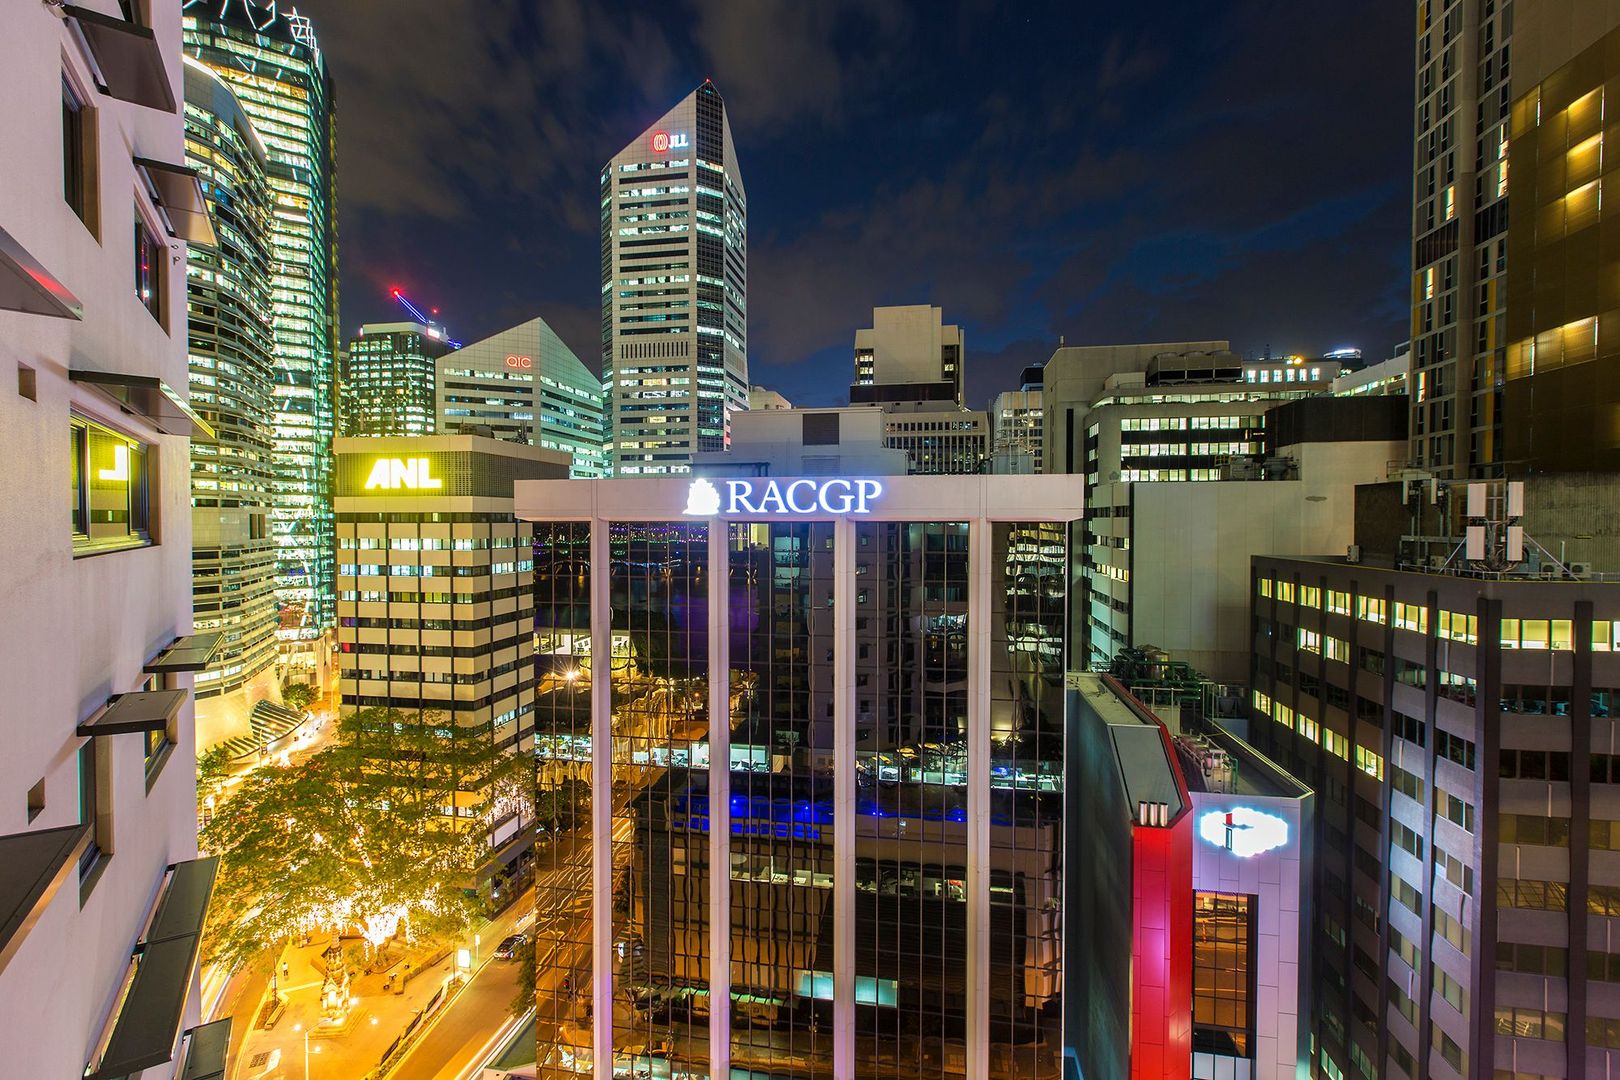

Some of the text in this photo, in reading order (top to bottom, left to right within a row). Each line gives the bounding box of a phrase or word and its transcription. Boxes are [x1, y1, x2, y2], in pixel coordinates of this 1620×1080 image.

[669, 134, 689, 149] JLL
[364, 458, 442, 489] ANL
[725, 480, 882, 514] RACGP
